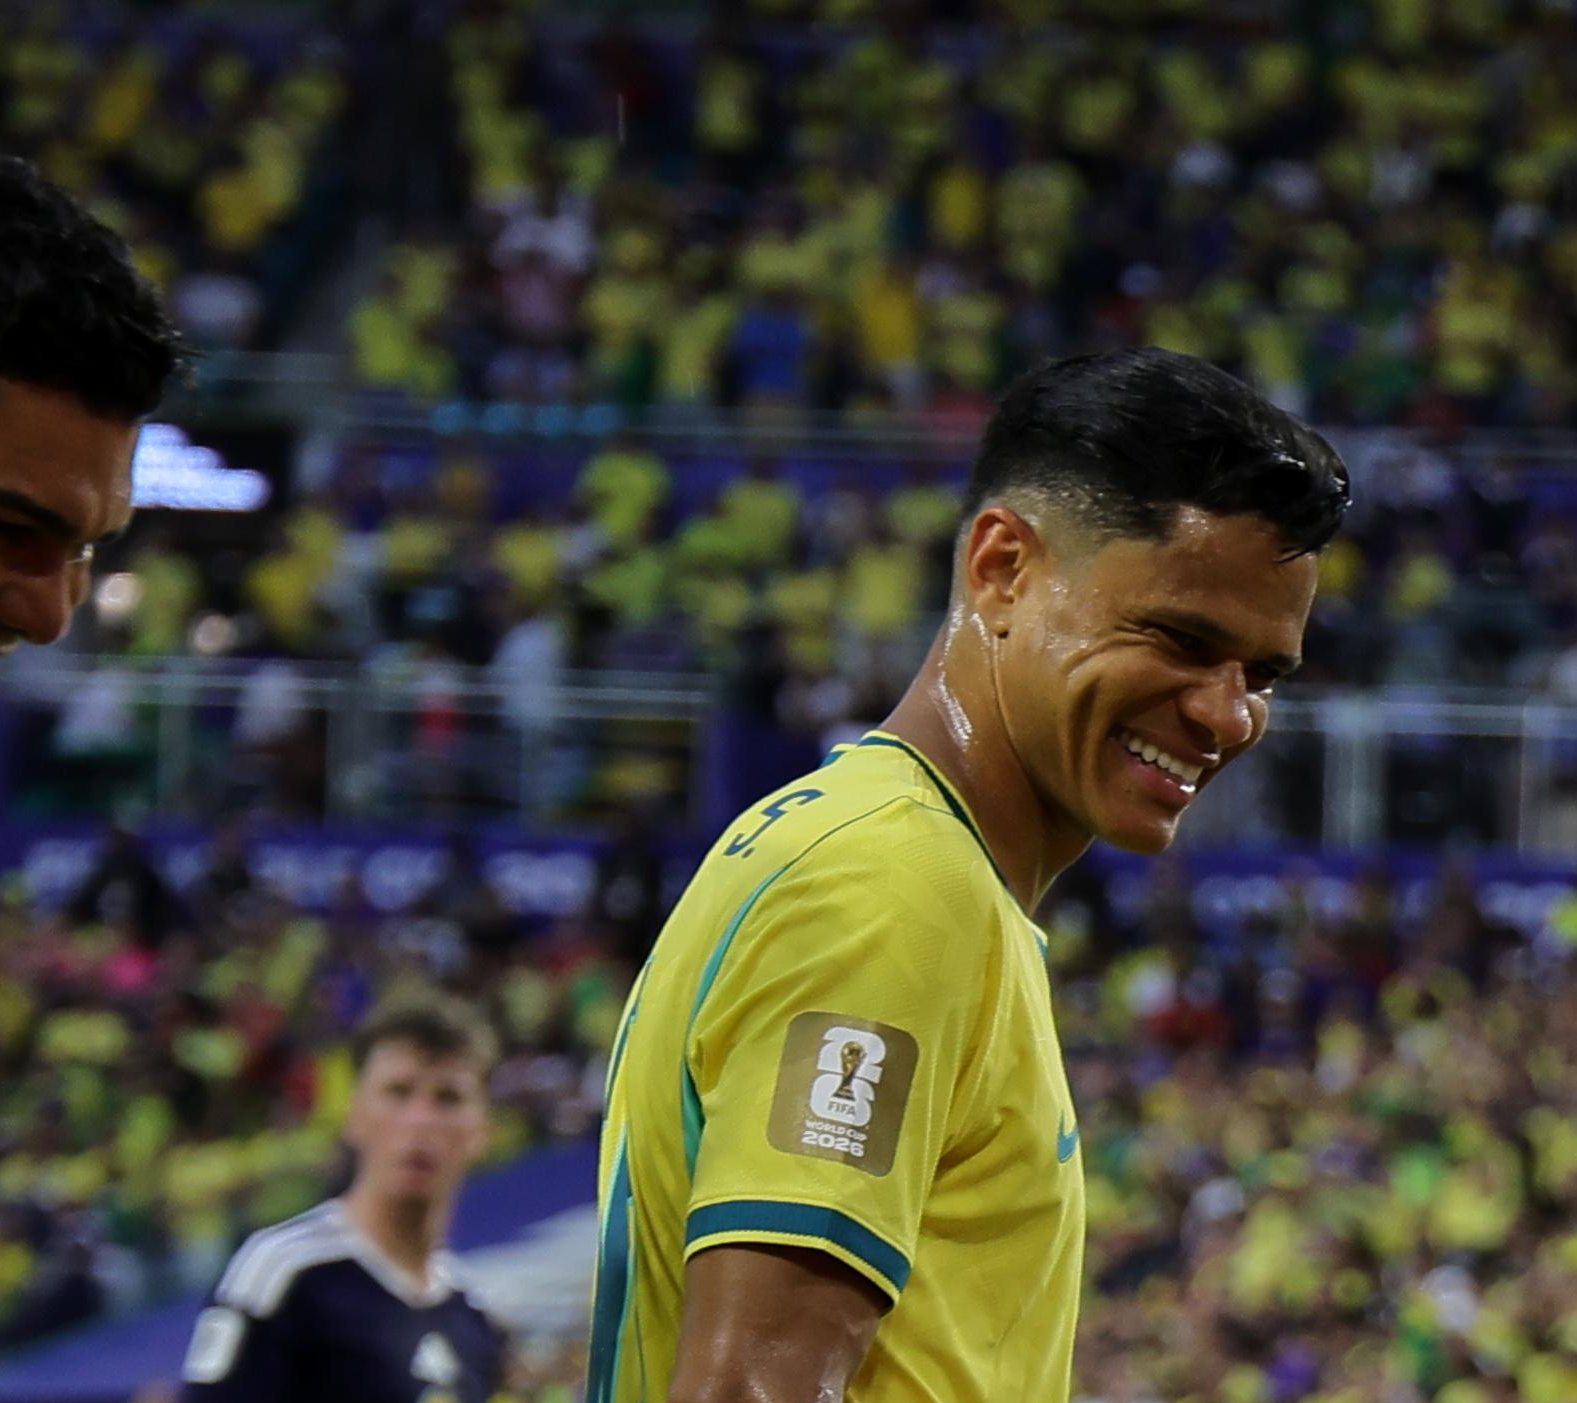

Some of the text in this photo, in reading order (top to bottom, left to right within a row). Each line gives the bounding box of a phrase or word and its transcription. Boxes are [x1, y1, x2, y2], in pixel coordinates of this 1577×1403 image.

[826, 1101, 857, 1117] FIFA
[804, 1119, 868, 1142] WORLD CUP
[801, 1130, 865, 1158] 2026
